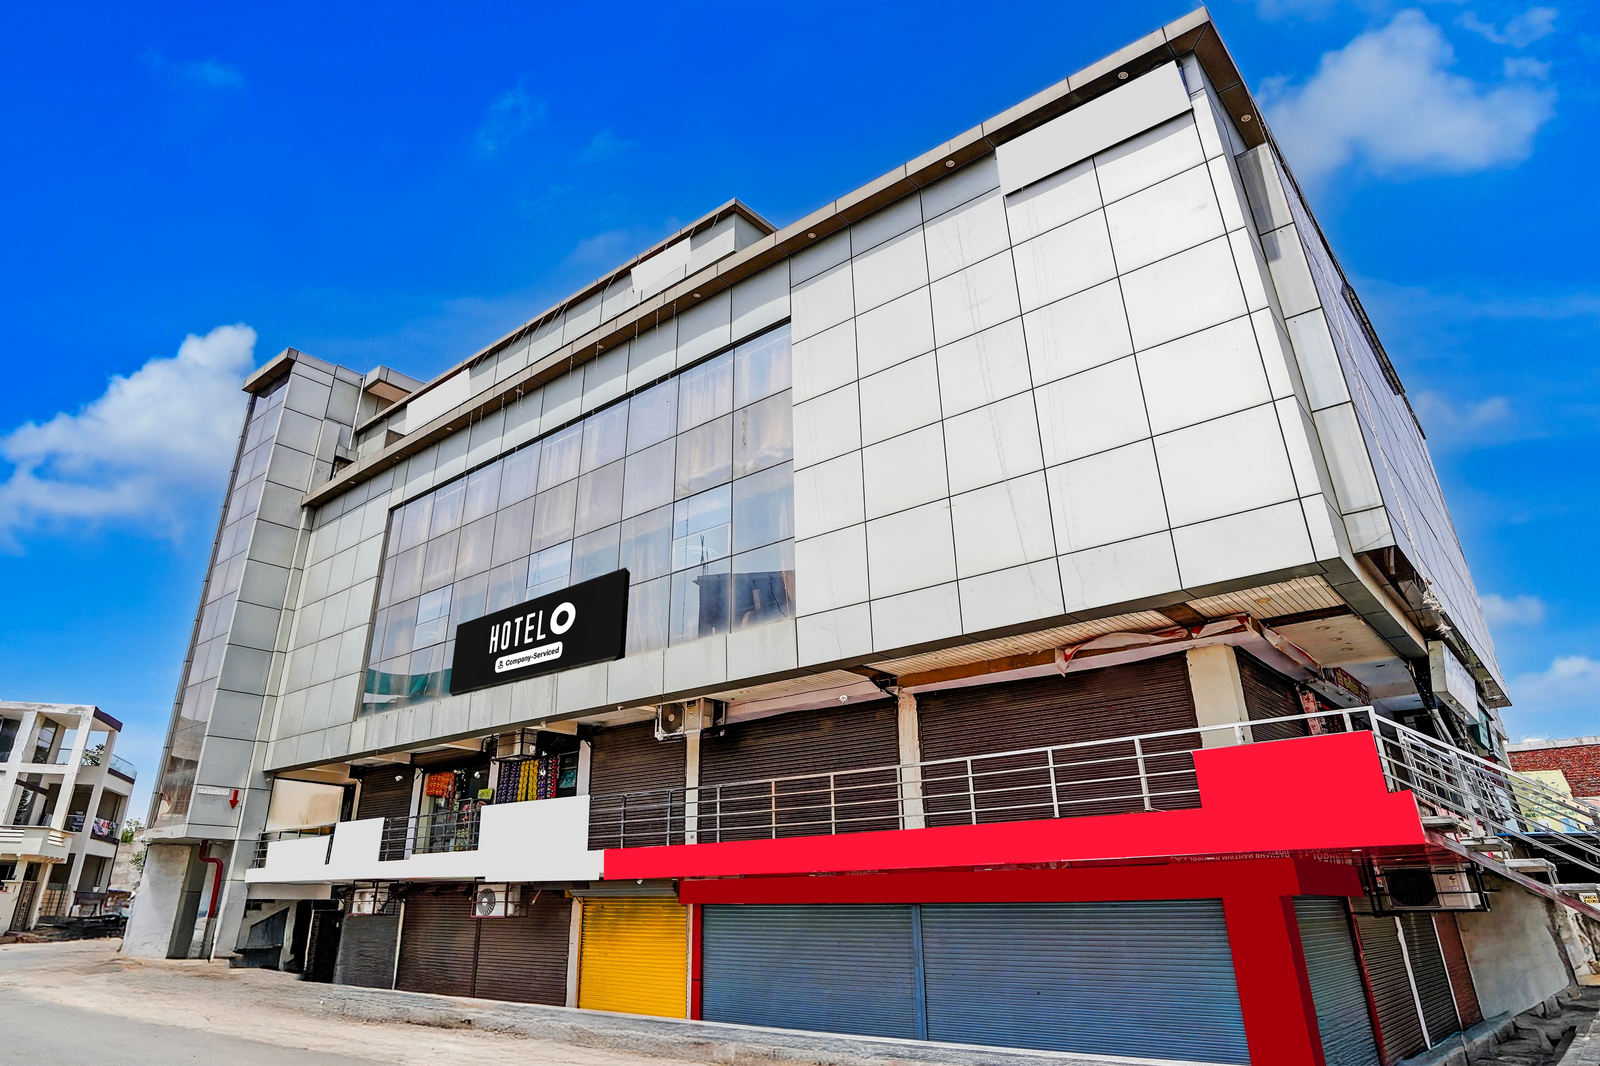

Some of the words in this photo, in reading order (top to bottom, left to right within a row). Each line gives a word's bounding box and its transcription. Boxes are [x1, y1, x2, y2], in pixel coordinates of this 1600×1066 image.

[489, 610, 546, 654] HOTEL
[550, 602, 576, 635] O
[505, 646, 560, 667] Company-Serviced
